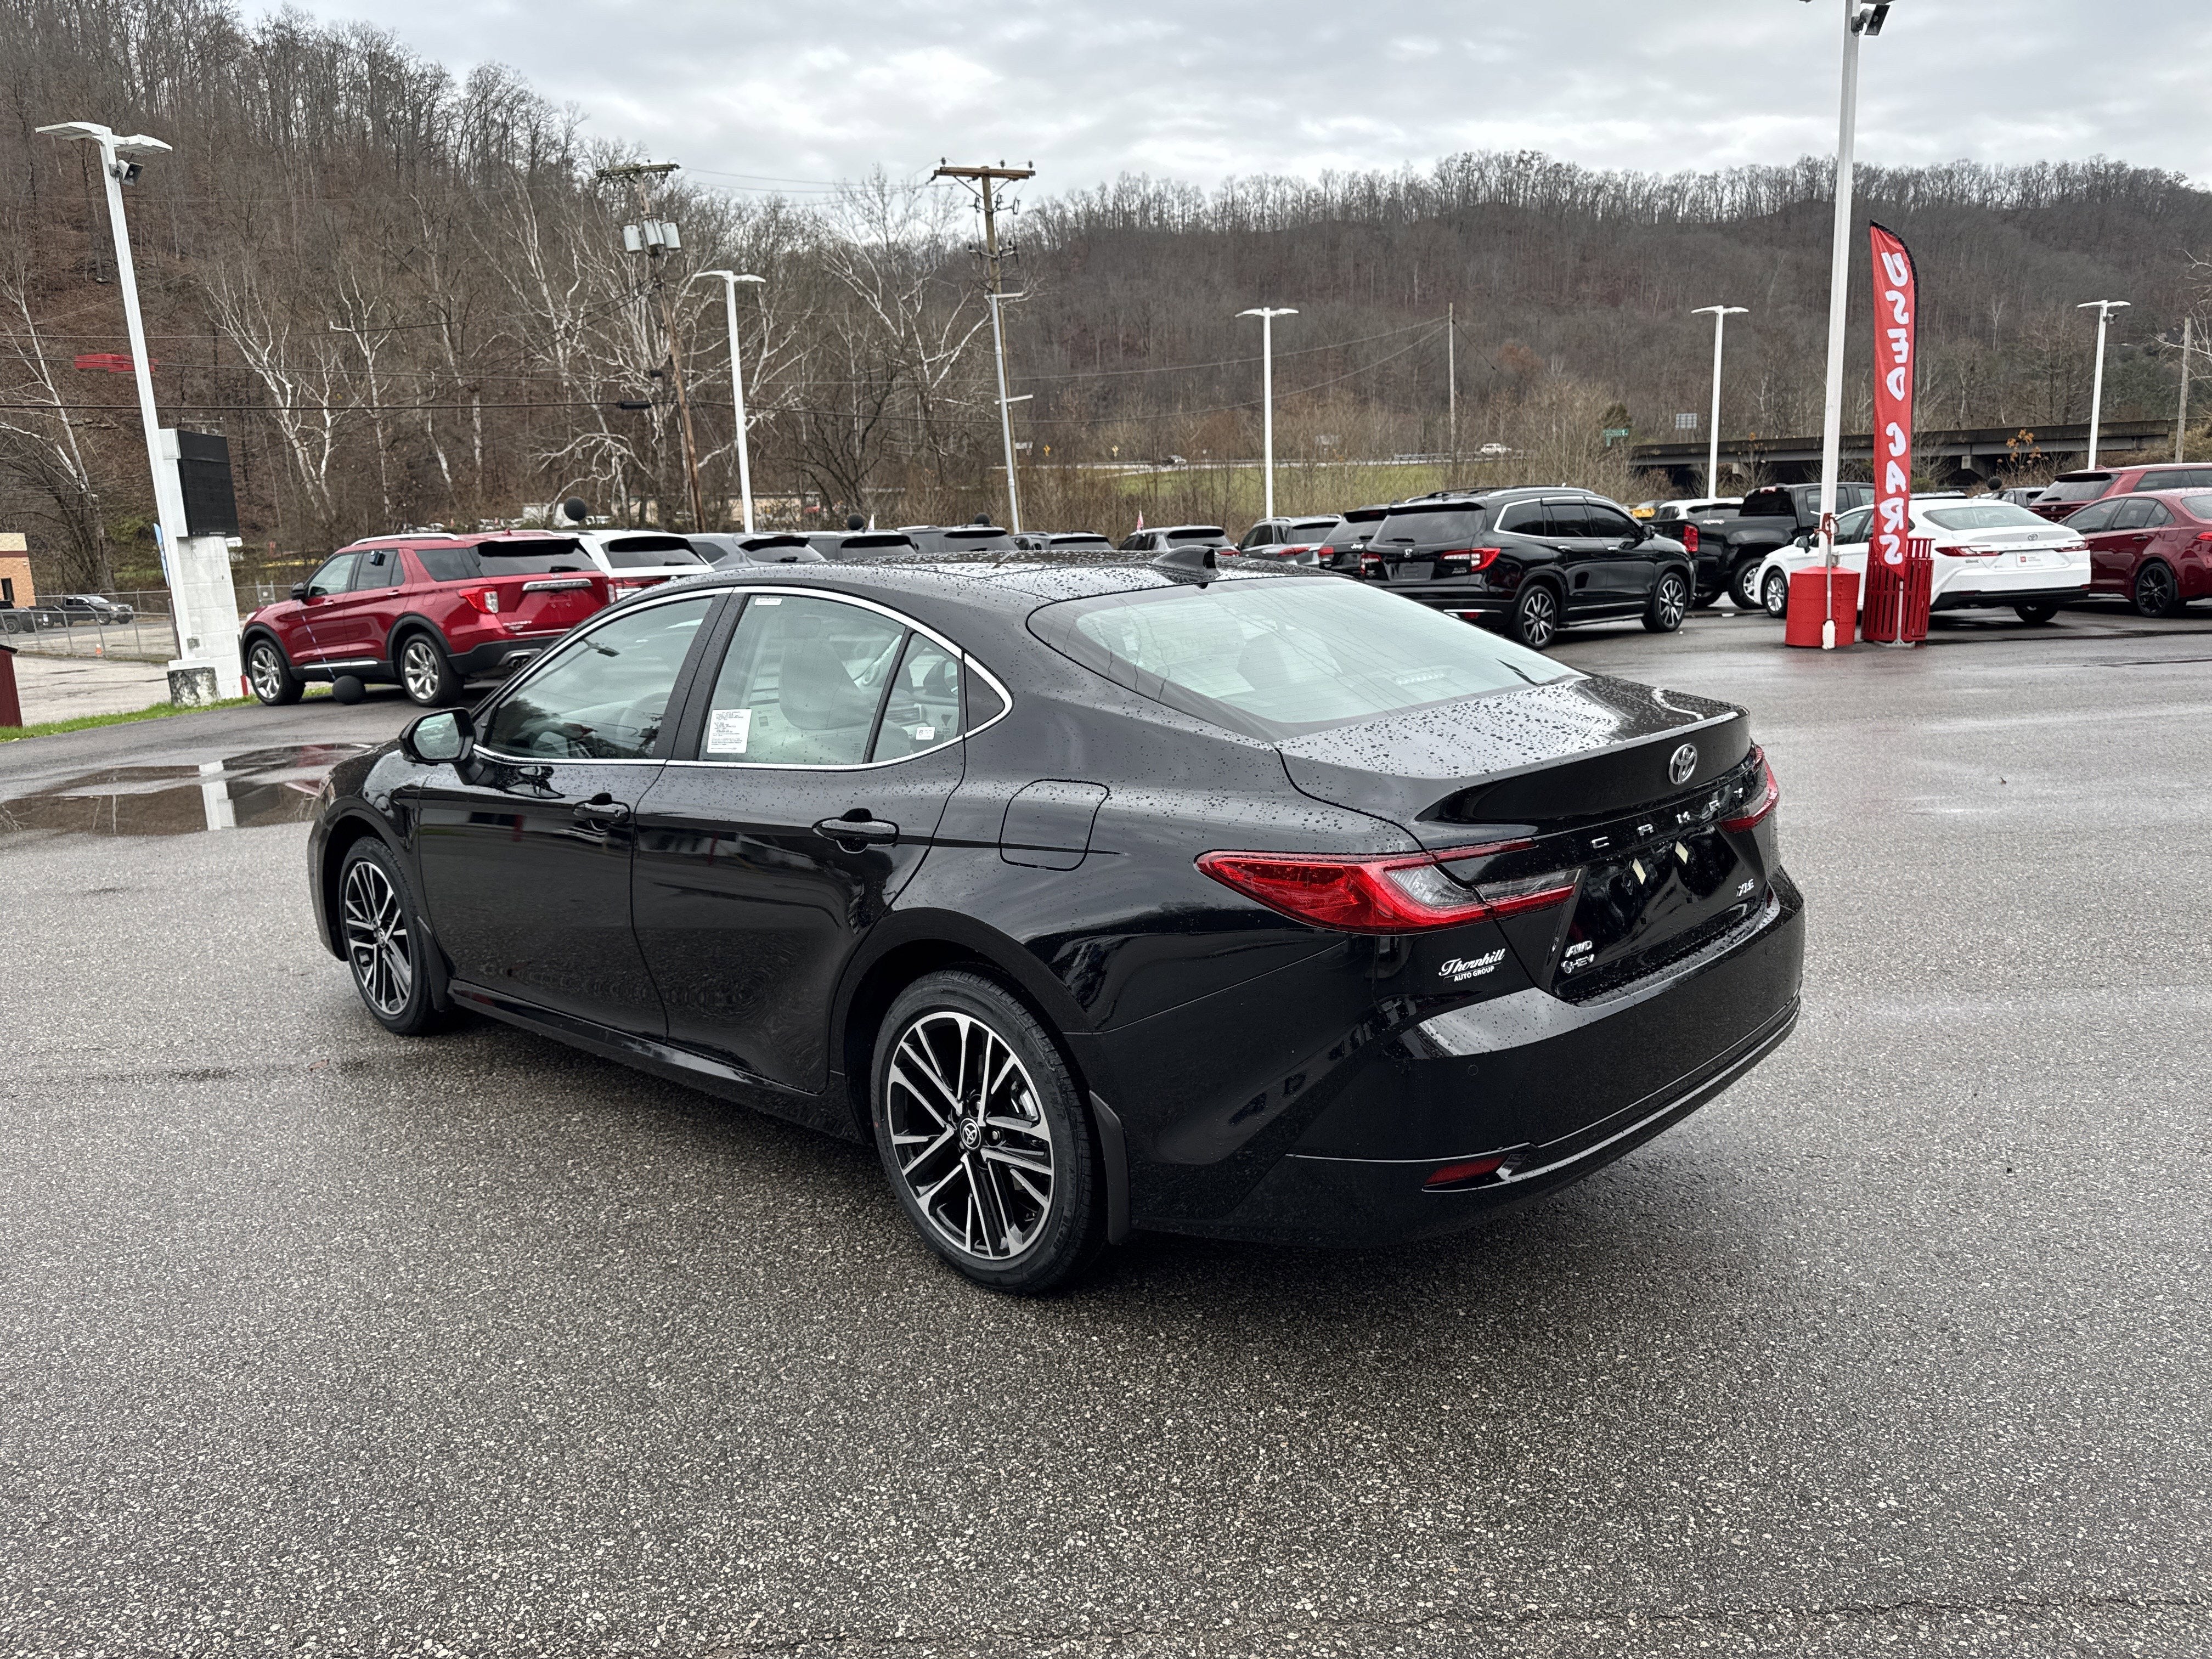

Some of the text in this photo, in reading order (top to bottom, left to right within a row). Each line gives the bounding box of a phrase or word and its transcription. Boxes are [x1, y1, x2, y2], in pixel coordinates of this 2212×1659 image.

[1591, 788, 1743, 849] CAMRY
[1736, 879, 1754, 897] XLE
[1565, 940, 1593, 957] AWD
[1438, 948, 1505, 976] Thornhill
[1454, 966, 1494, 982] AUTO GROUP
